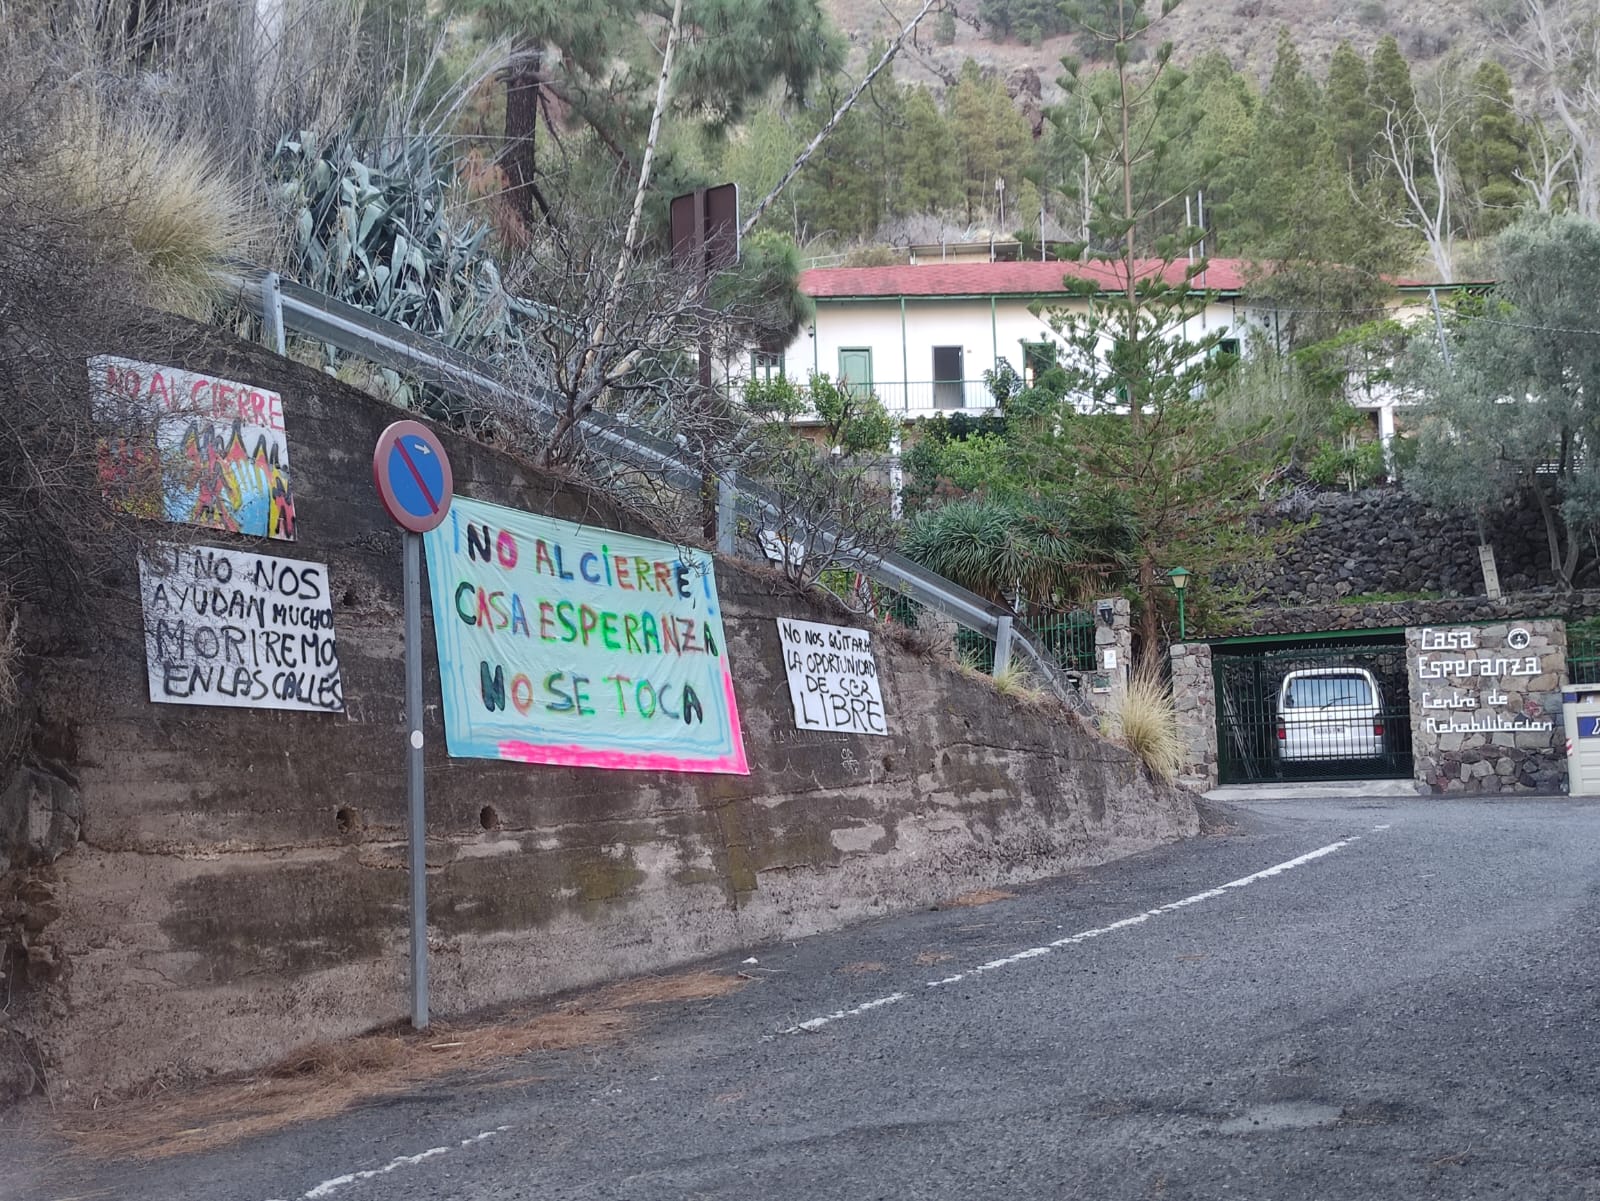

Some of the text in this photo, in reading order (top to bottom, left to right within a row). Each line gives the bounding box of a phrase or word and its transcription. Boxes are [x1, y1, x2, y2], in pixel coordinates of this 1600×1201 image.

[106, 365, 141, 398] NO
[190, 379, 286, 431] CIERRE
[194, 549, 233, 584] NO
[255, 559, 321, 600] NOS
[535, 538, 574, 581] AL
[153, 583, 266, 629] AYUDAN
[454, 581, 719, 657] CASA ESPERANZA
[782, 621, 802, 644] NO
[805, 629, 825, 648] NOS
[1421, 628, 1477, 651] Casa
[787, 649, 876, 678] LA OPORTUNIDAD
[1418, 656, 1542, 679] Esperanza
[163, 661, 345, 711] EN LAS CALLES
[480, 660, 534, 718] NO
[543, 672, 596, 716] SE
[604, 673, 704, 725] TOCA
[805, 674, 874, 700] DE SER
[1422, 688, 1508, 709] Centro de
[800, 690, 884, 733] LIBRE
